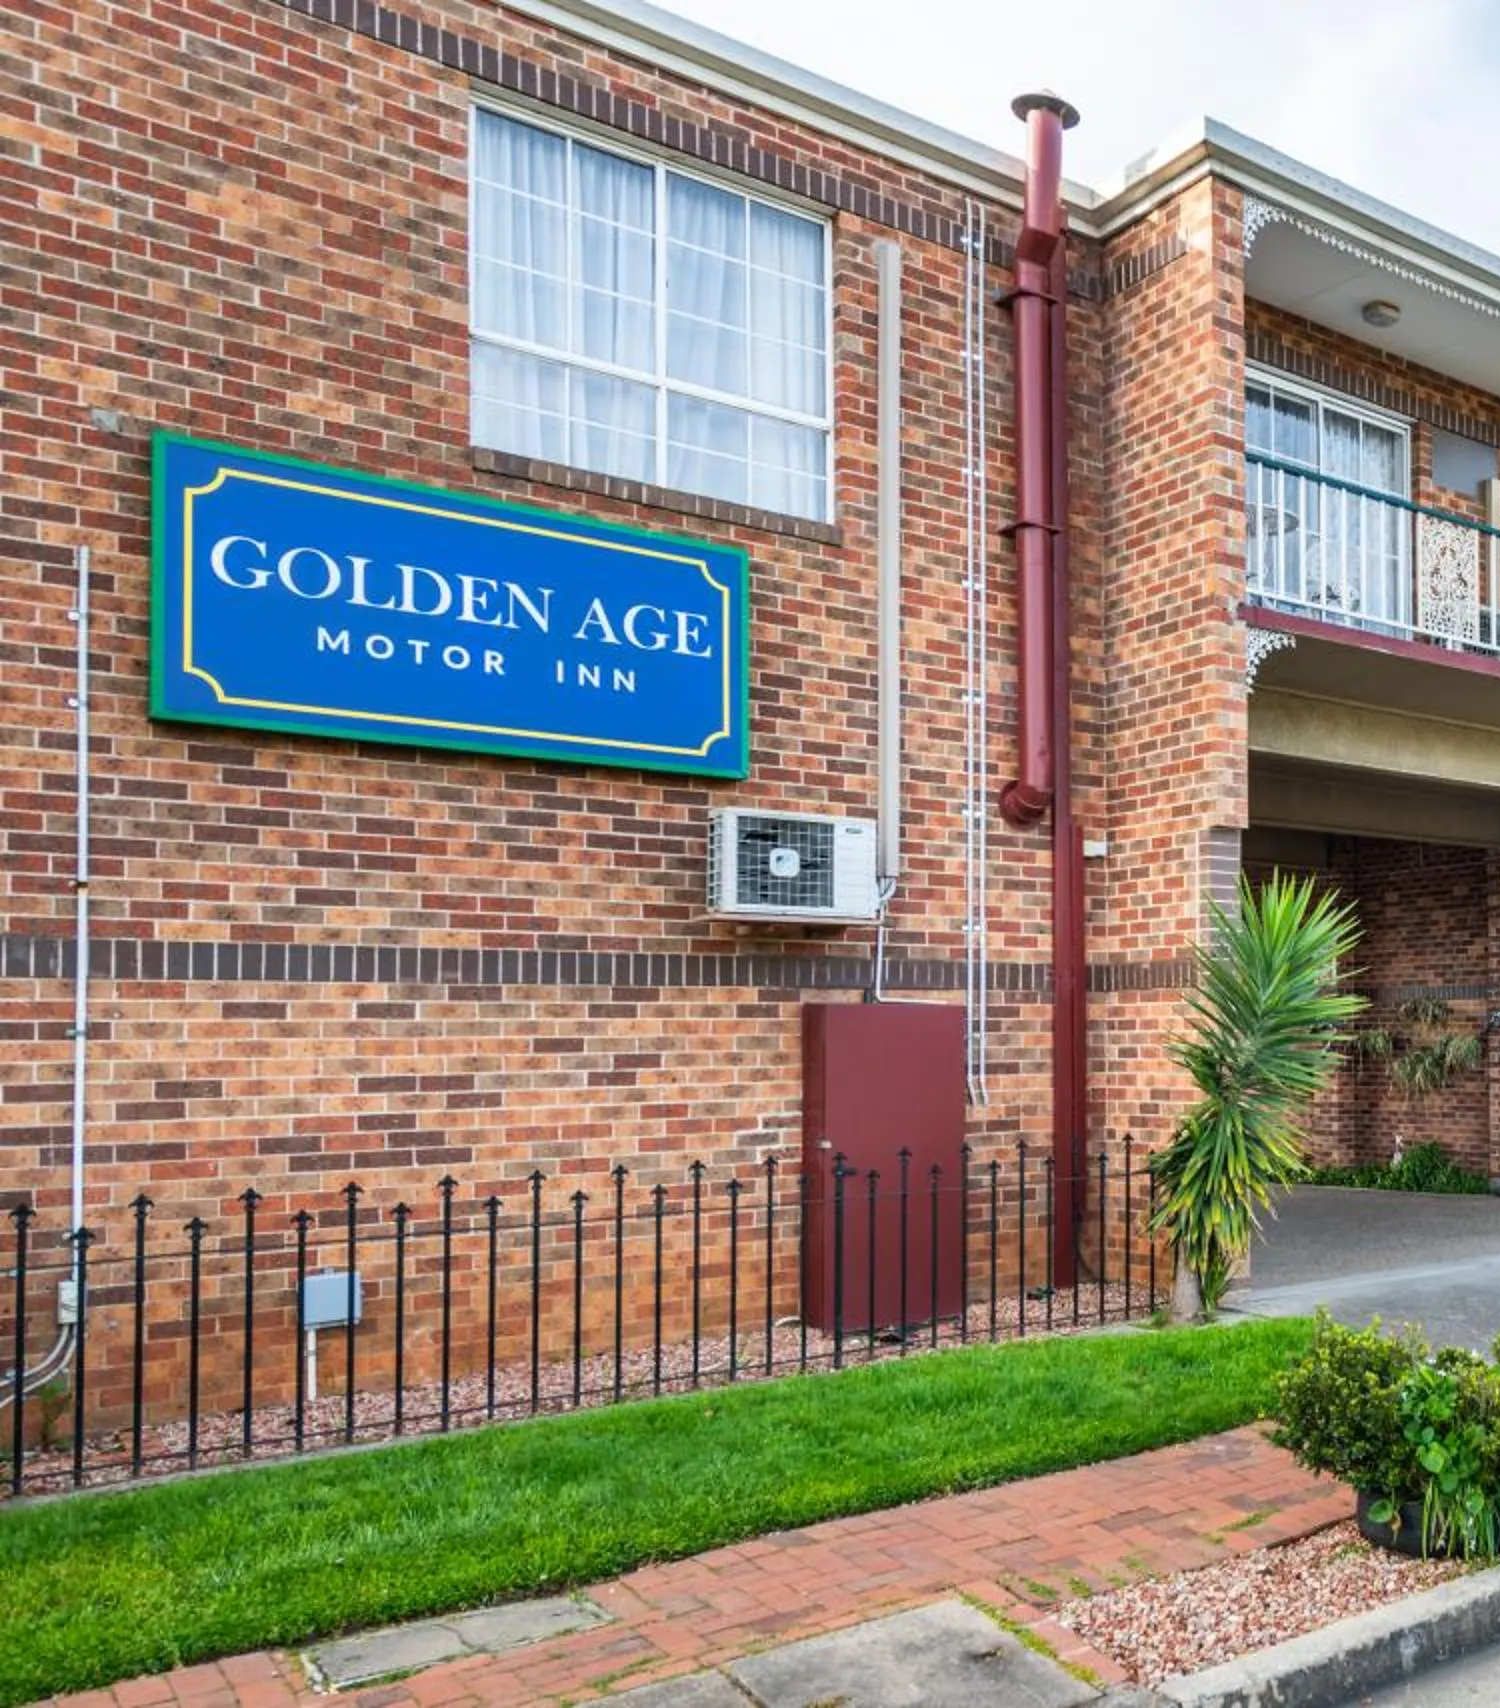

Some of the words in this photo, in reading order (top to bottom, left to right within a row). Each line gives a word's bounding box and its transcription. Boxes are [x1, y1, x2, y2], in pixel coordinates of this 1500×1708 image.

[210, 535, 554, 633] GOLDEN
[574, 597, 712, 658] AGE
[317, 626, 505, 675] MOTOR
[556, 660, 637, 692] INN
